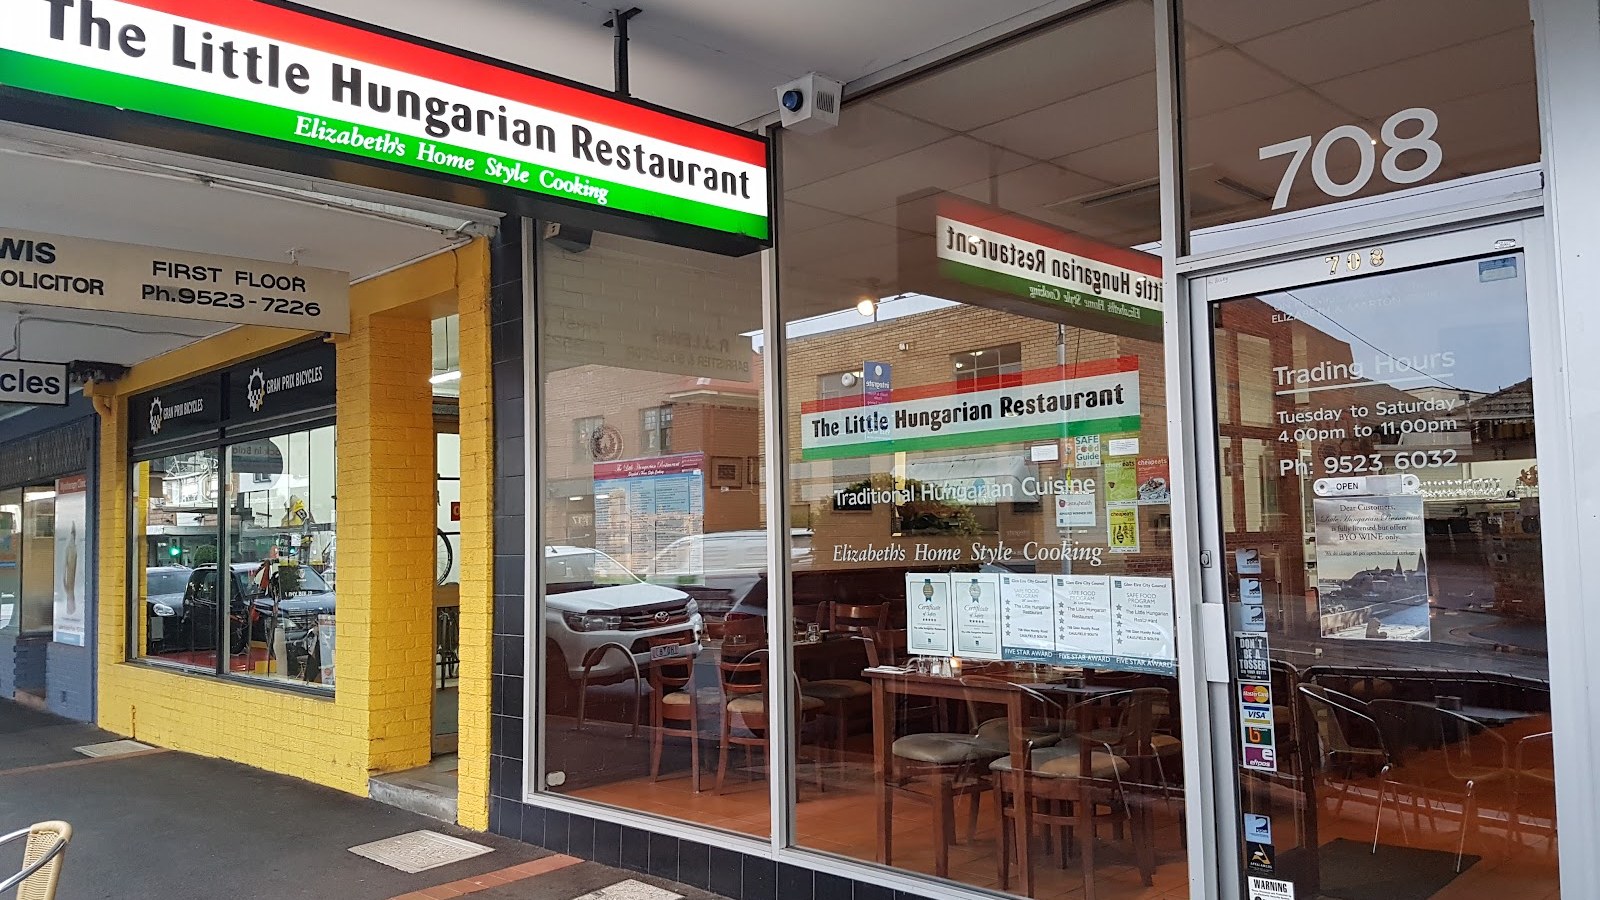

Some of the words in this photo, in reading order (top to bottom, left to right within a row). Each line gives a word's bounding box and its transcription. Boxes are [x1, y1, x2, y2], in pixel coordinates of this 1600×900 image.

[46, 0, 146, 58] The
[172, 24, 310, 94] Little
[332, 63, 556, 153] Hungarian
[572, 124, 750, 200] Restaurant
[294, 115, 406, 158] Elizabeth's
[416, 142, 474, 172] Home
[485, 155, 529, 184] Style
[539, 170, 608, 204] Cooking
[1259, 107, 1442, 210] 708
[0, 269, 104, 296] OLICITOR
[153, 260, 222, 284] FIRST
[235, 271, 306, 293] FLOOR
[0, 368, 60, 395] cles
[266, 379, 281, 394] GRAN
[282, 376, 294, 391] PRIX
[296, 366, 323, 386] BICYCLES
[1273, 361, 1364, 386] Trading
[1375, 351, 1455, 374] Hours
[163, 408, 174, 420] GRAN
[184, 398, 203, 414] BICYCLES
[812, 418, 839, 438] The
[845, 412, 888, 434] Little
[895, 401, 992, 431] Hungarian
[1000, 384, 1124, 418] Restaurant
[1277, 405, 1342, 424] Tuesday
[1351, 404, 1368, 418] to
[1376, 398, 1455, 416] Saturday
[1076, 435, 1099, 444] SAFE
[1278, 427, 1345, 444] 4.00pm
[1354, 424, 1371, 437] to
[1380, 417, 1457, 435] 11.00pm
[1076, 453, 1099, 461] Guide
[1280, 457, 1313, 476] Ph:
[1324, 454, 1383, 474] 9523
[1394, 449, 1457, 471] 6032
[834, 483, 915, 507] Traditional
[921, 480, 1014, 505] Hungarian
[1021, 476, 1096, 496] Cuisine
[1336, 482, 1359, 490] OPEN
[1337, 525, 1352, 533] fully
[832, 543, 906, 563] Elizabeth's
[915, 543, 961, 561] Home
[971, 541, 1012, 564] Style
[1024, 540, 1103, 566] Cooking
[1240, 638, 1263, 649] DON'T
[1243, 649, 1252, 659] BE
[1255, 649, 1260, 659] A
[1145, 660, 1173, 668] AWARD
[1239, 659, 1267, 670] TOSSER
[1248, 711, 1266, 719] VISA
[1249, 759, 1270, 767] eftpos
[1253, 879, 1287, 892] WARNING
